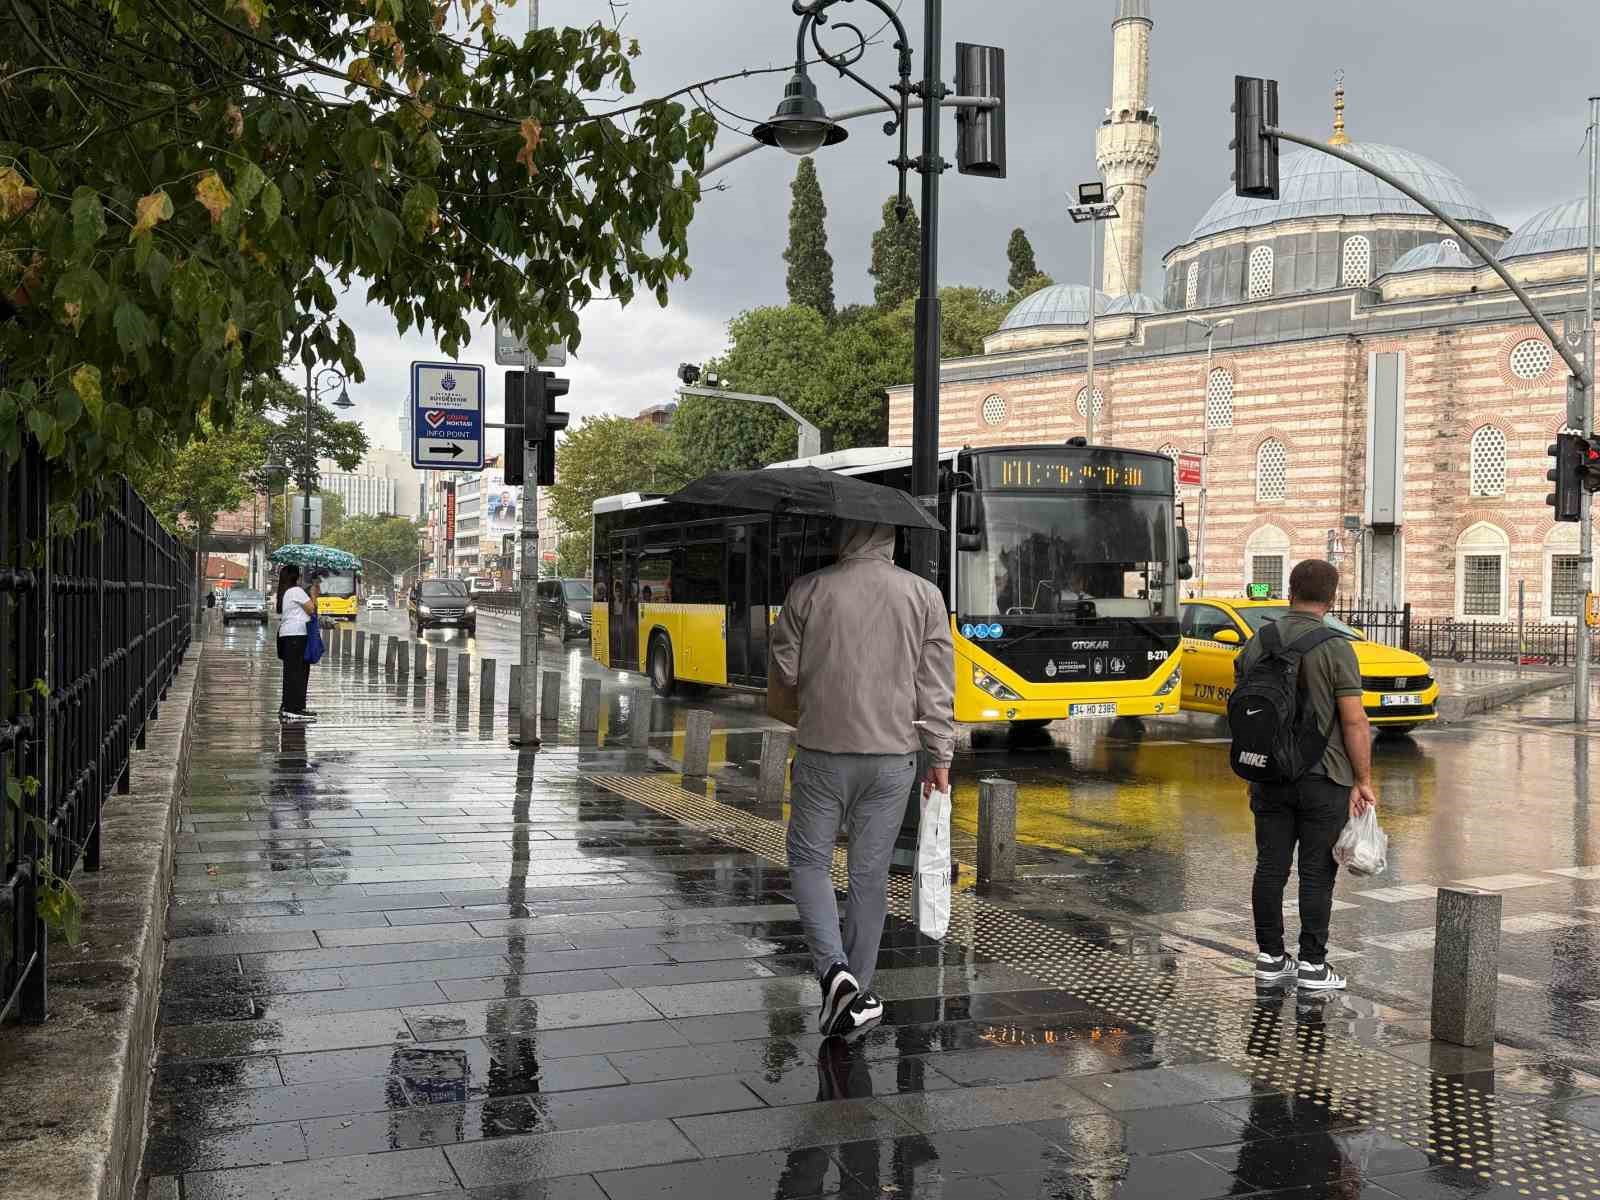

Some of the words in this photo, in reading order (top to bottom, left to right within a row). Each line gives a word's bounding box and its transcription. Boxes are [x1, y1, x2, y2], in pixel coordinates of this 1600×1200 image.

[427, 429, 445, 437] INFO
[1072, 640, 1110, 650] OTOKAR
[1147, 650, 1168, 661] B-270
[1194, 683, 1216, 698] TJN
[1238, 751, 1268, 768] NIKE
